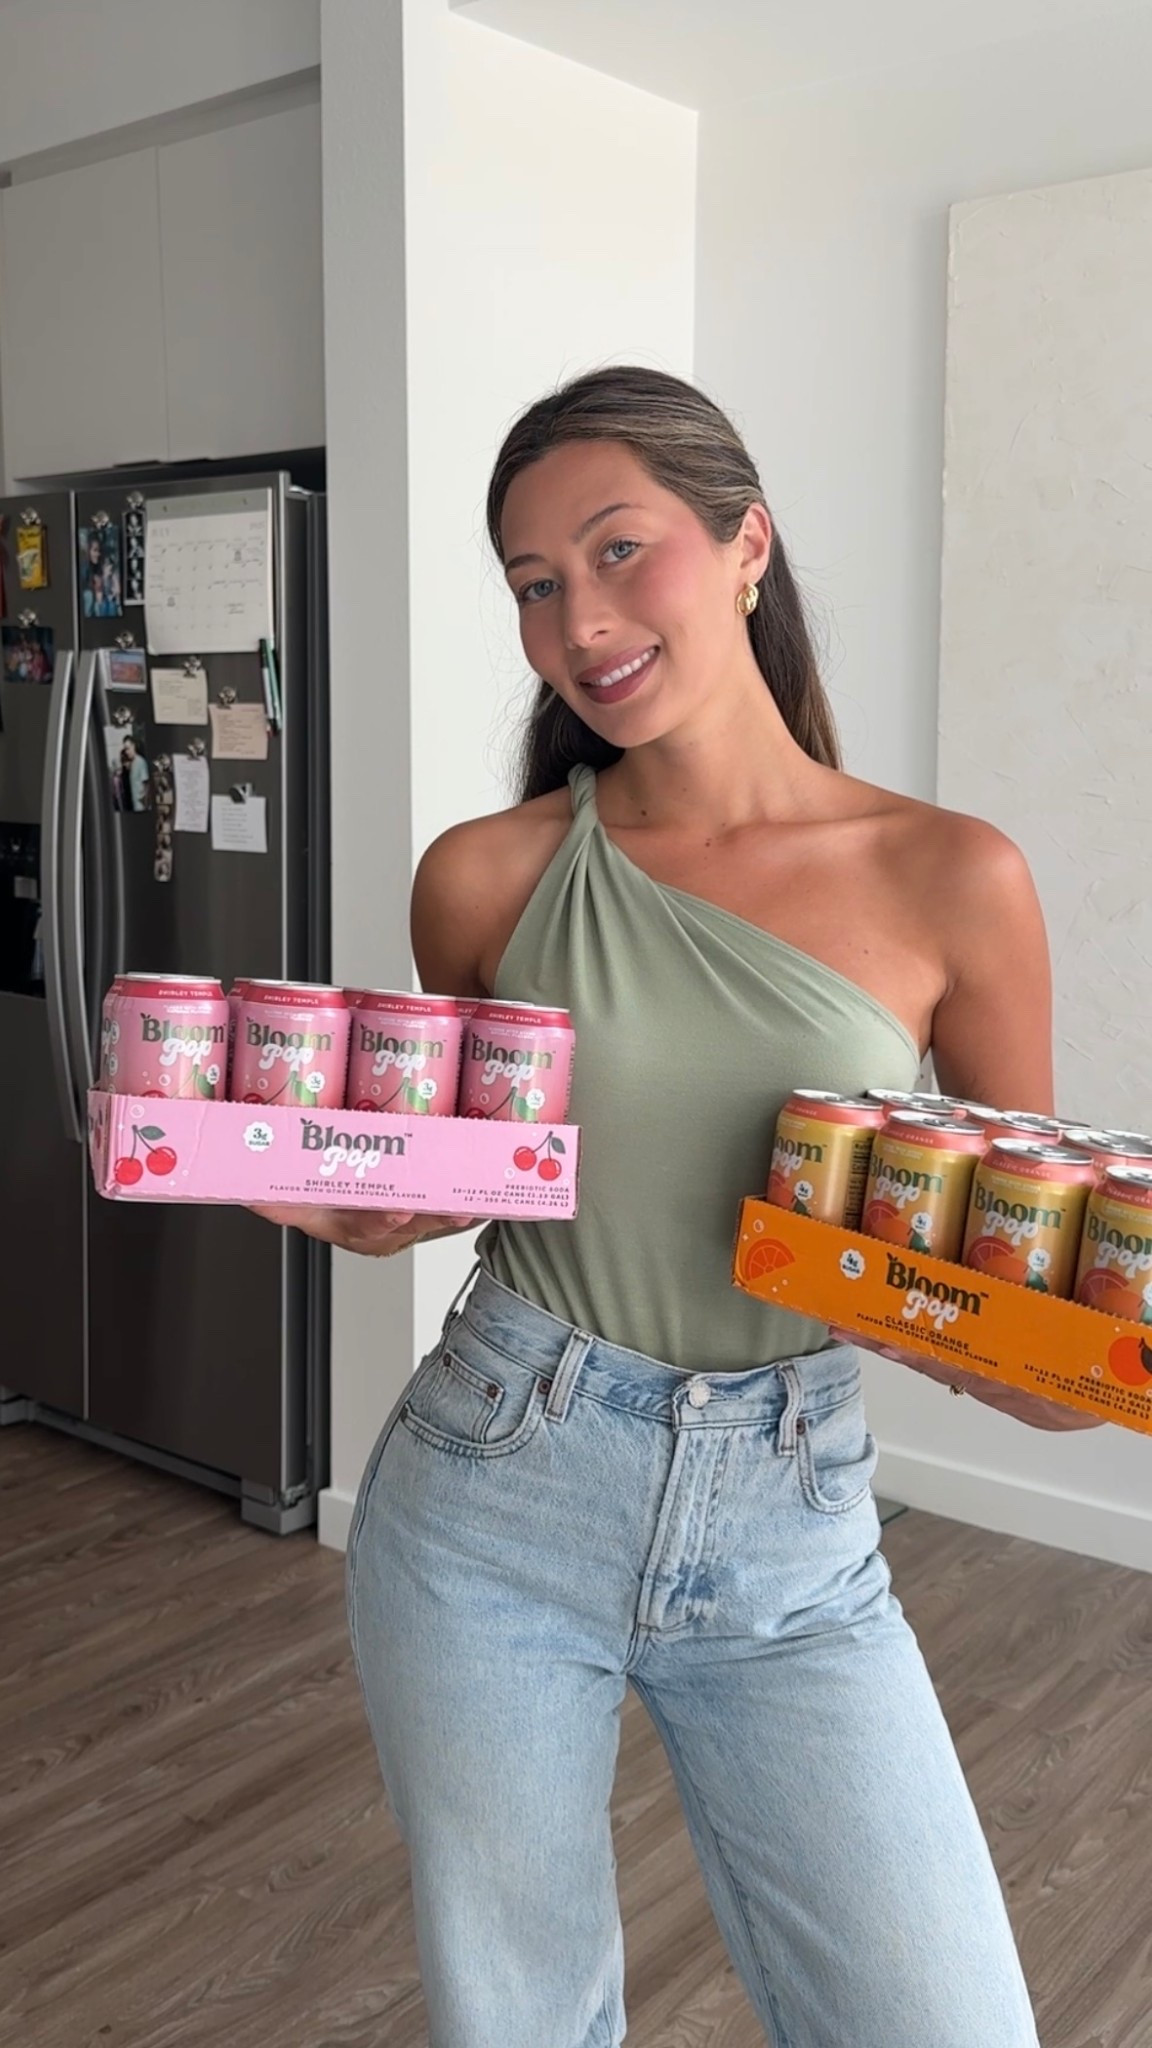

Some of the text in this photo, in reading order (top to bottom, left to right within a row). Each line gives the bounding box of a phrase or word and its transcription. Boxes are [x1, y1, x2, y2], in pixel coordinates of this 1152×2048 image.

[259, 1043, 315, 1071] Pop
[372, 1050, 427, 1078] Pop
[481, 1060, 536, 1088] Pop
[319, 1146, 381, 1178] Pop
[305, 1179, 395, 1191] SHIRLEY TEMPLE
[391, 1192, 427, 1200] FLAVORS
[505, 1184, 546, 1192] PREBIOTIC
[981, 1210, 1038, 1246] Pop
[902, 1290, 959, 1330] Pop
[856, 1312, 883, 1326] FLAVOR
[964, 1349, 999, 1368] FLAVORS
[885, 1315, 970, 1350] CLASSIC ORANGE
